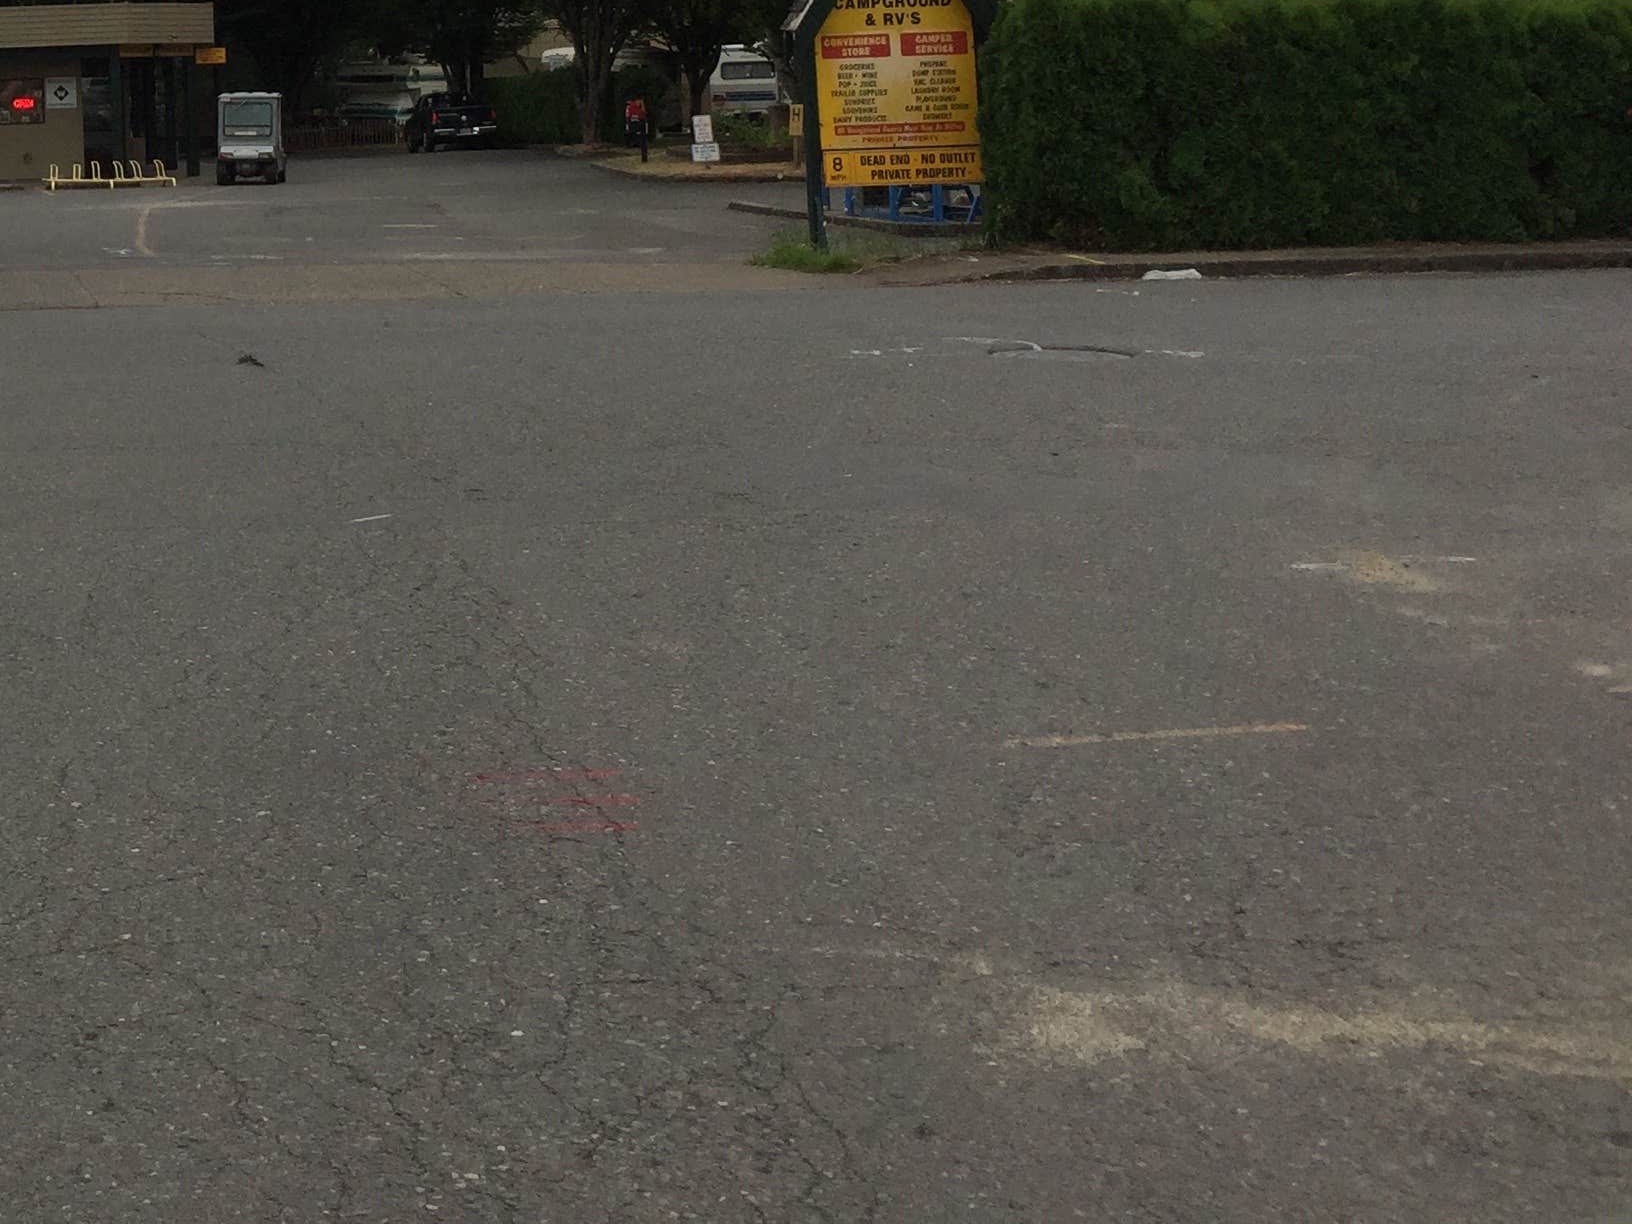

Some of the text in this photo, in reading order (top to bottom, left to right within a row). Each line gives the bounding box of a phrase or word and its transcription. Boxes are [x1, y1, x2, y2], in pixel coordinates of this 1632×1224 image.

[865, 12, 921, 26] & RV'S
[824, 36, 887, 47] CONVENIENCE
[915, 34, 953, 43] CAMPER
[842, 47, 871, 56] STORE
[915, 44, 954, 54] SERVICE
[793, 107, 801, 121] H
[832, 157, 843, 172] 8
[860, 152, 976, 167] DEAD END NO OUTLET
[871, 167, 967, 180] PRIVATE PROPERTY
